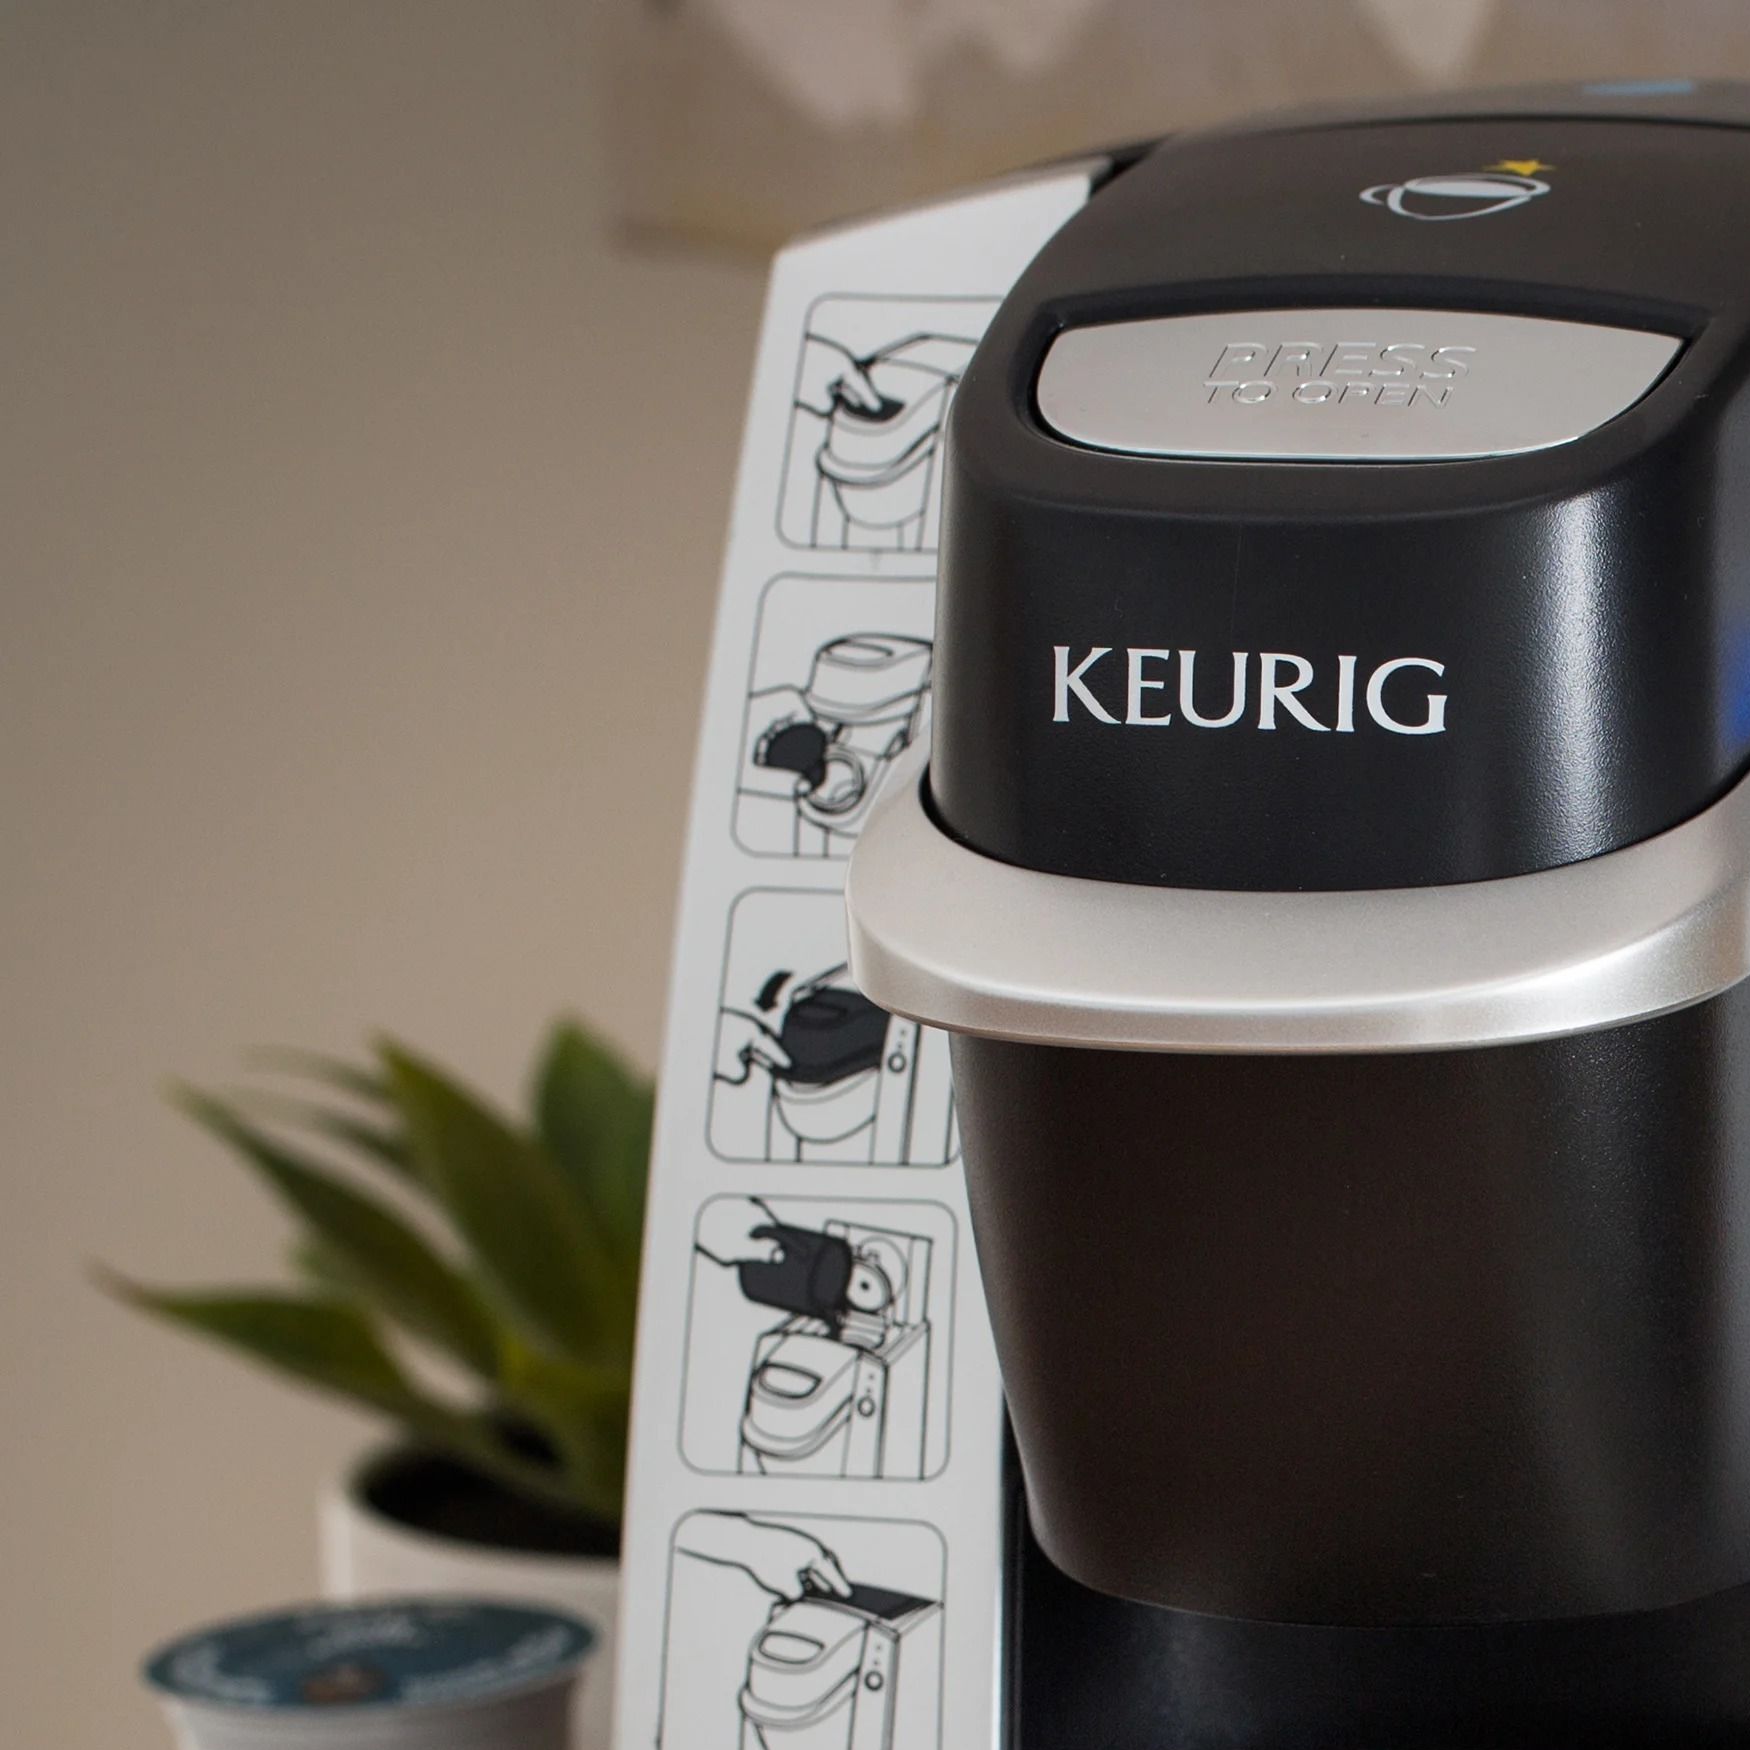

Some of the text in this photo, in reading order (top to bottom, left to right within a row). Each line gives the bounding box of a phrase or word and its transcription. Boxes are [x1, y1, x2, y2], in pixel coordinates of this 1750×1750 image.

[1208, 340, 1478, 379] PRESS
[1203, 379, 1456, 409] TO OPEN
[1052, 645, 1449, 735] KEURIG
